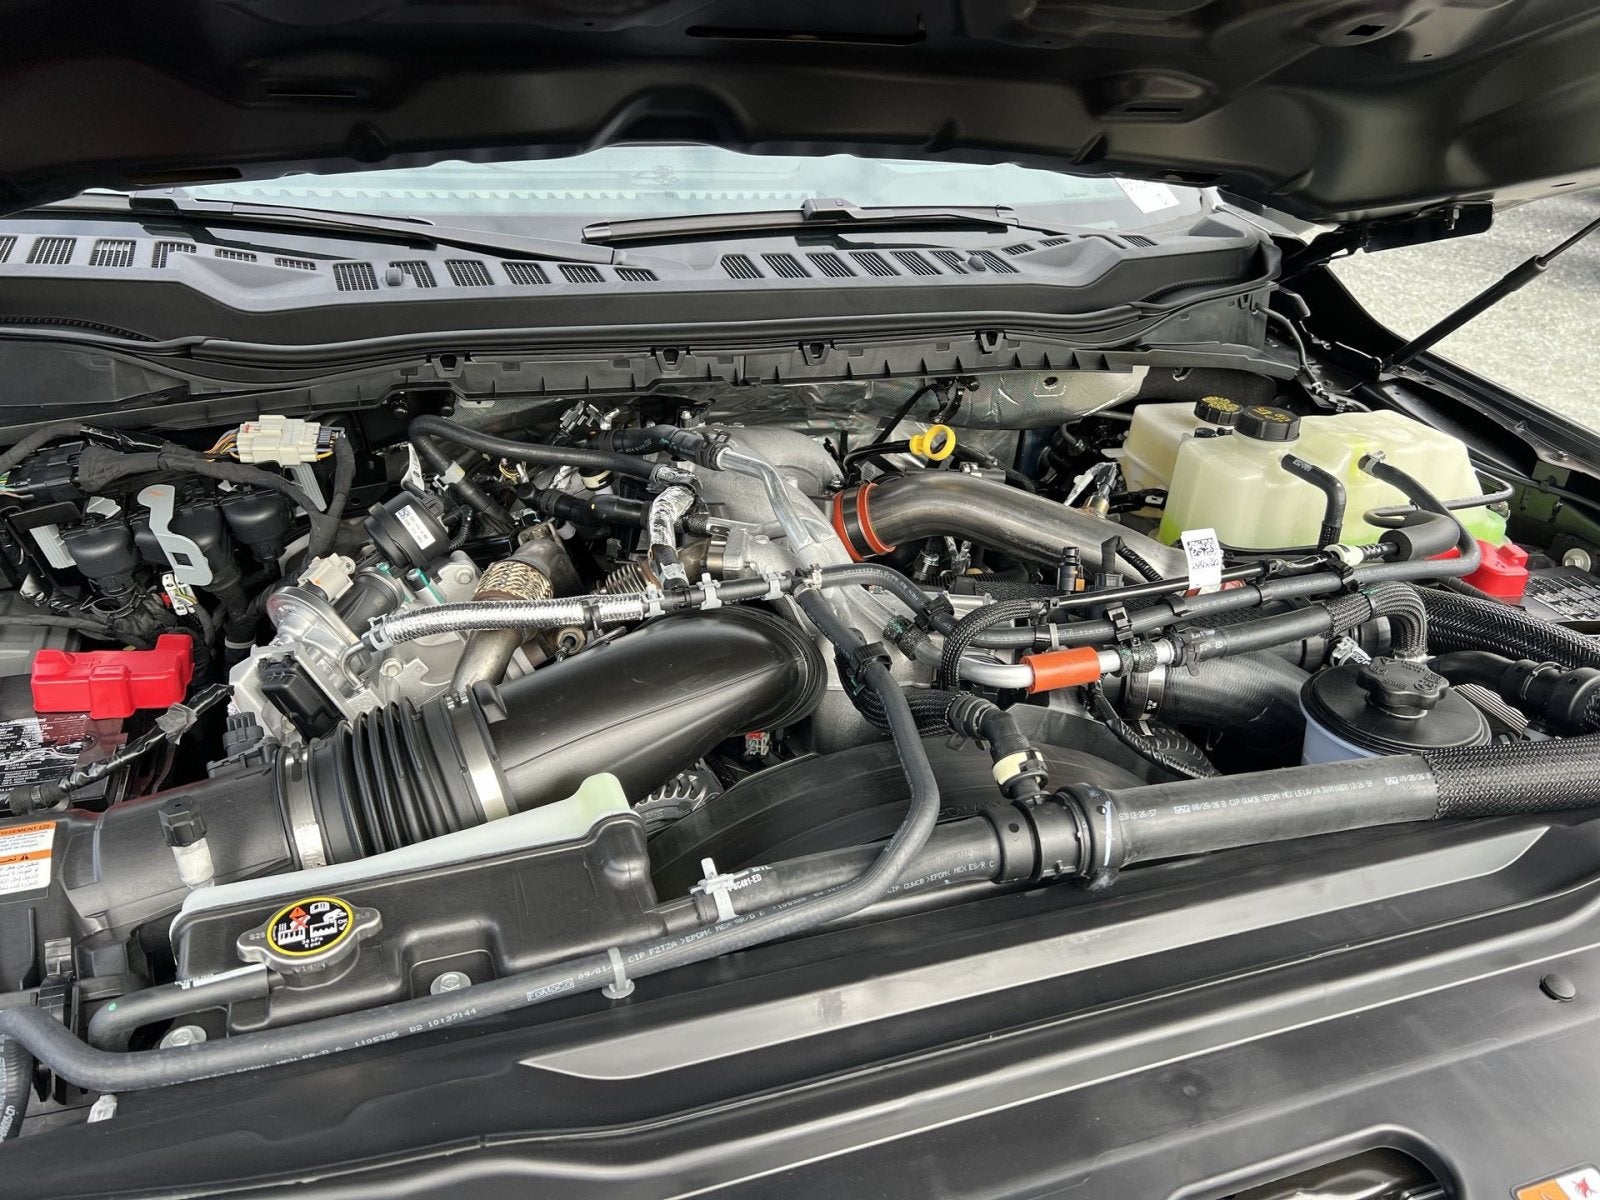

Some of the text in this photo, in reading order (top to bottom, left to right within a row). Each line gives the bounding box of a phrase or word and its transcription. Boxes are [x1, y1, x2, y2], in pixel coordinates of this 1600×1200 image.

[628, 951, 646, 963] CIP
[715, 920, 733, 932] MEX
[427, 1007, 478, 1028] 10:27:44
